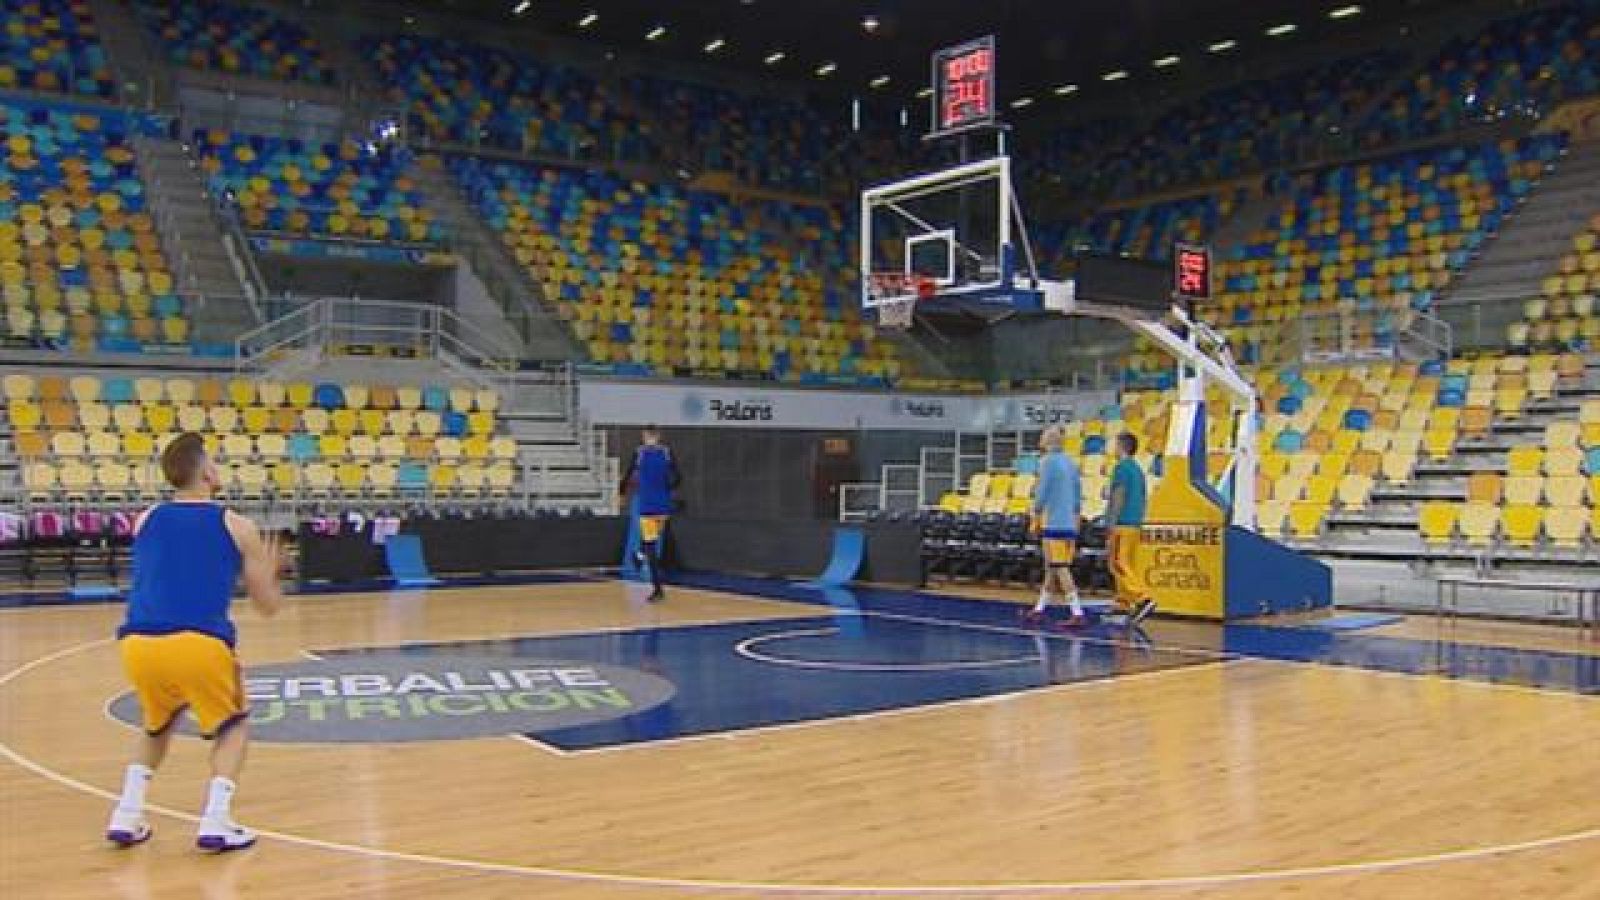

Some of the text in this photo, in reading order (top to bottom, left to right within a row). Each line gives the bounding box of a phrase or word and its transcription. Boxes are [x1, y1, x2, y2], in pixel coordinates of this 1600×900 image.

[945, 80, 986, 124] 24
[1155, 548, 1198, 568] Gran
[244, 668, 611, 698] ERBALIFE
[250, 688, 632, 725] UTRICIÓN
